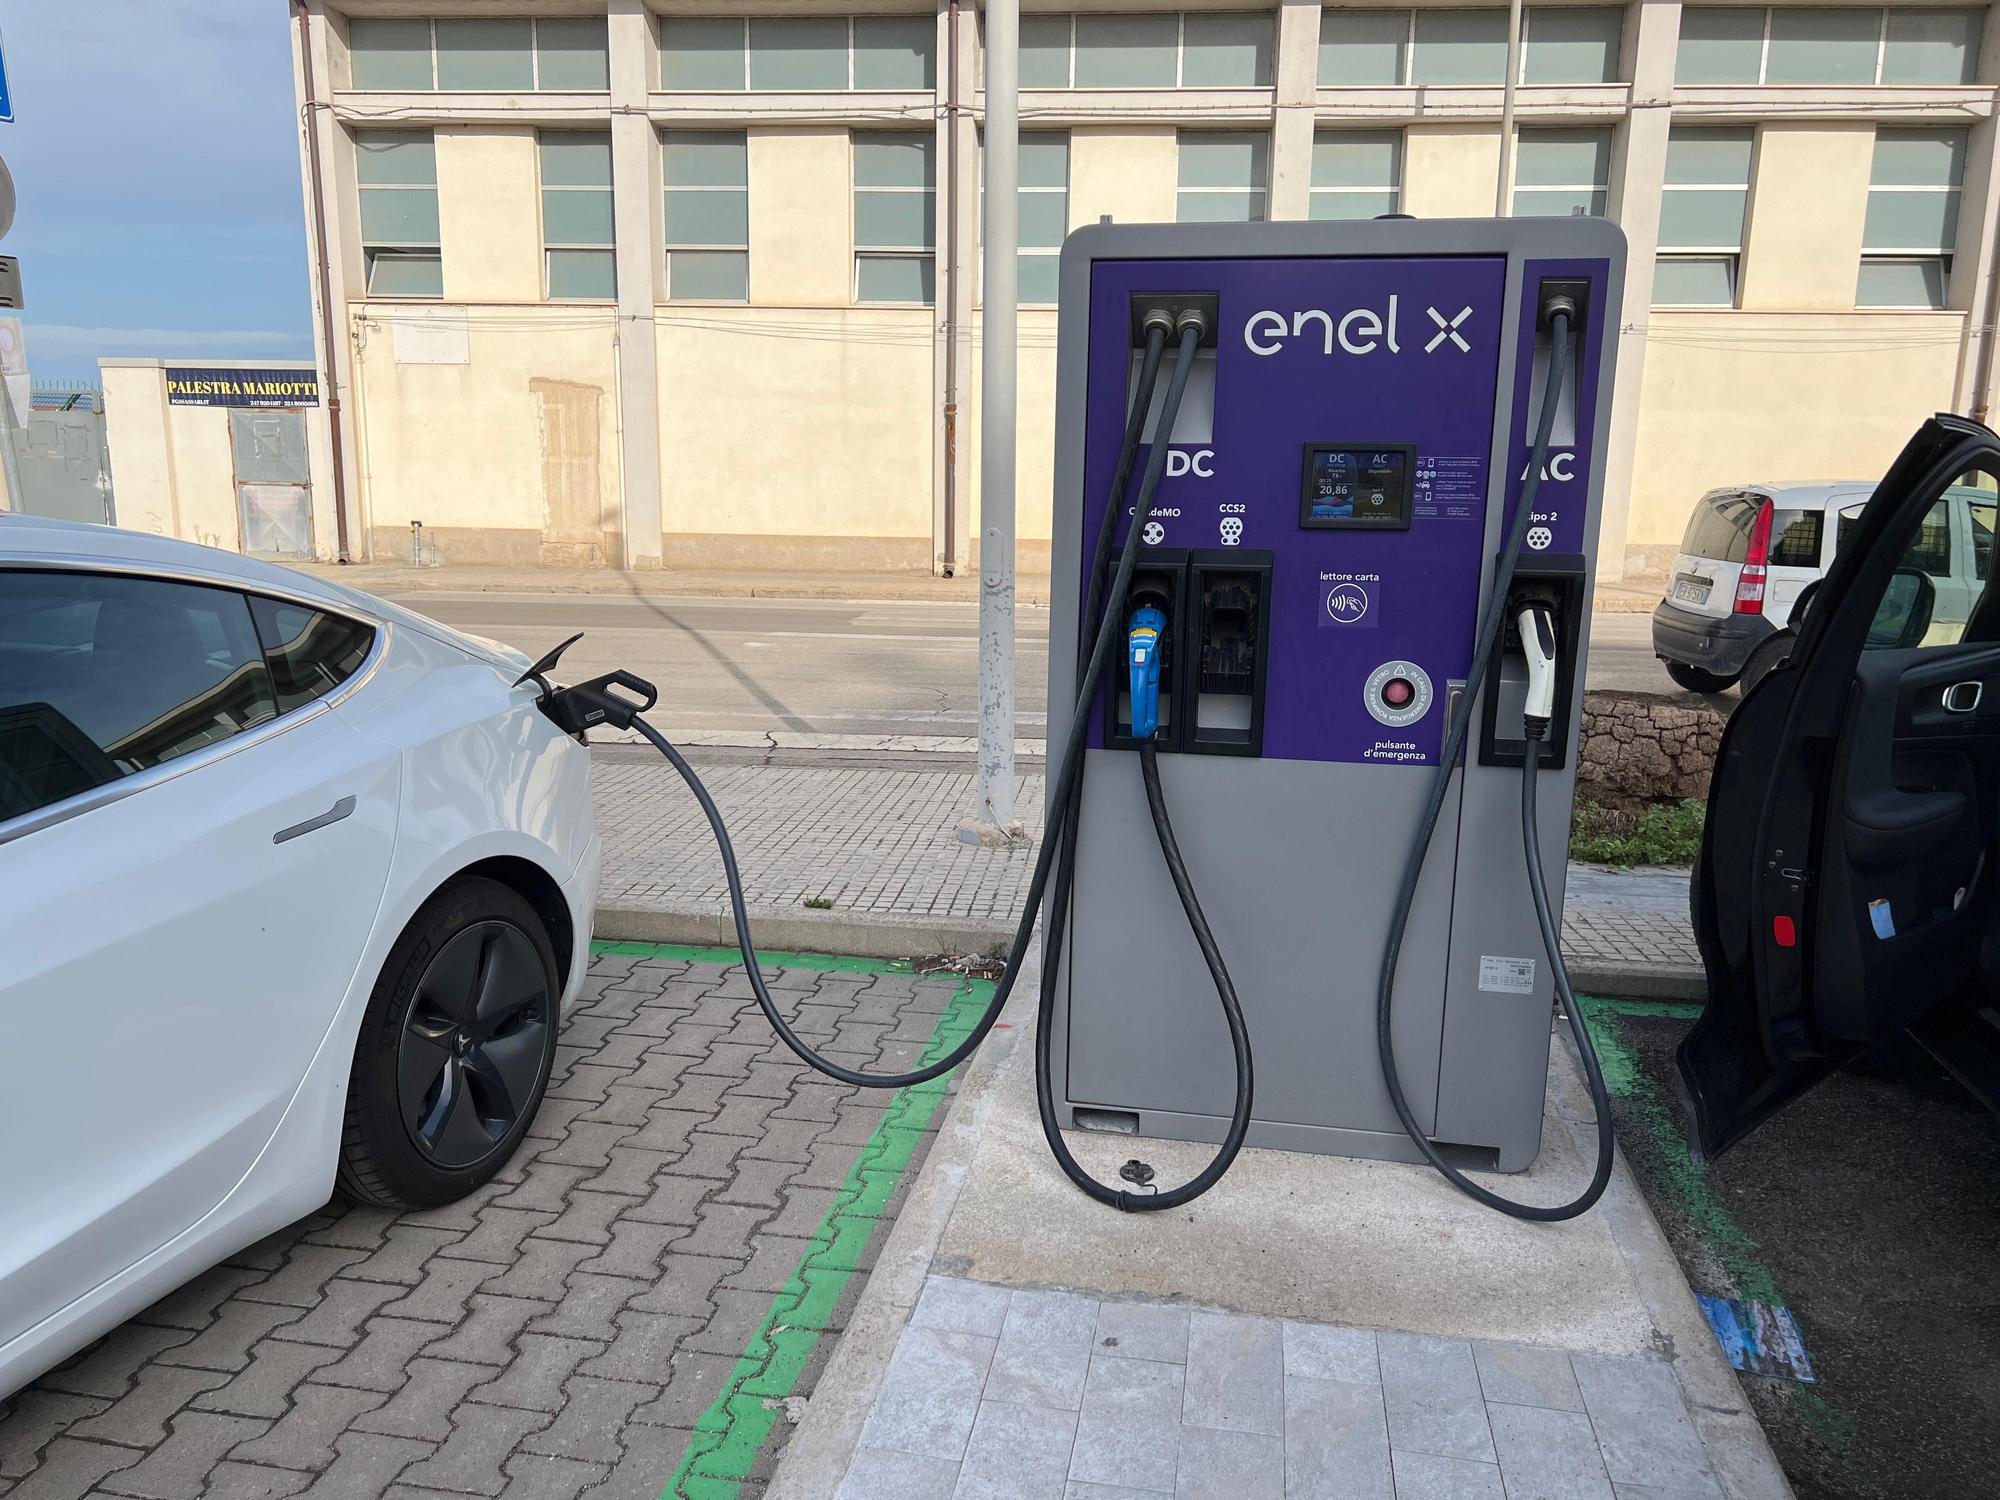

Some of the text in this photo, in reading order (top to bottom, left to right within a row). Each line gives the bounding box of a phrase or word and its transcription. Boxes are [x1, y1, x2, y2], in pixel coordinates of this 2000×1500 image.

[1244, 294, 1401, 356] enel
[167, 380, 318, 396] PALESTRA MARIOTTI
[1166, 449, 1215, 478] DC
[1329, 453, 1345, 463] DC
[1372, 454, 1388, 463] AC
[1320, 485, 1348, 496] 20,86
[1129, 507, 1181, 517] CdeMO
[1220, 504, 1246, 513] CCS2
[1528, 511, 1558, 523] ipo 2
[1320, 571, 1380, 581] lettore carta
[1372, 669, 1390, 686] VETRO
[1417, 677, 1427, 694] CASO
[1375, 740, 1416, 751] pulsante
[1363, 749, 1426, 760] d'emergenza
